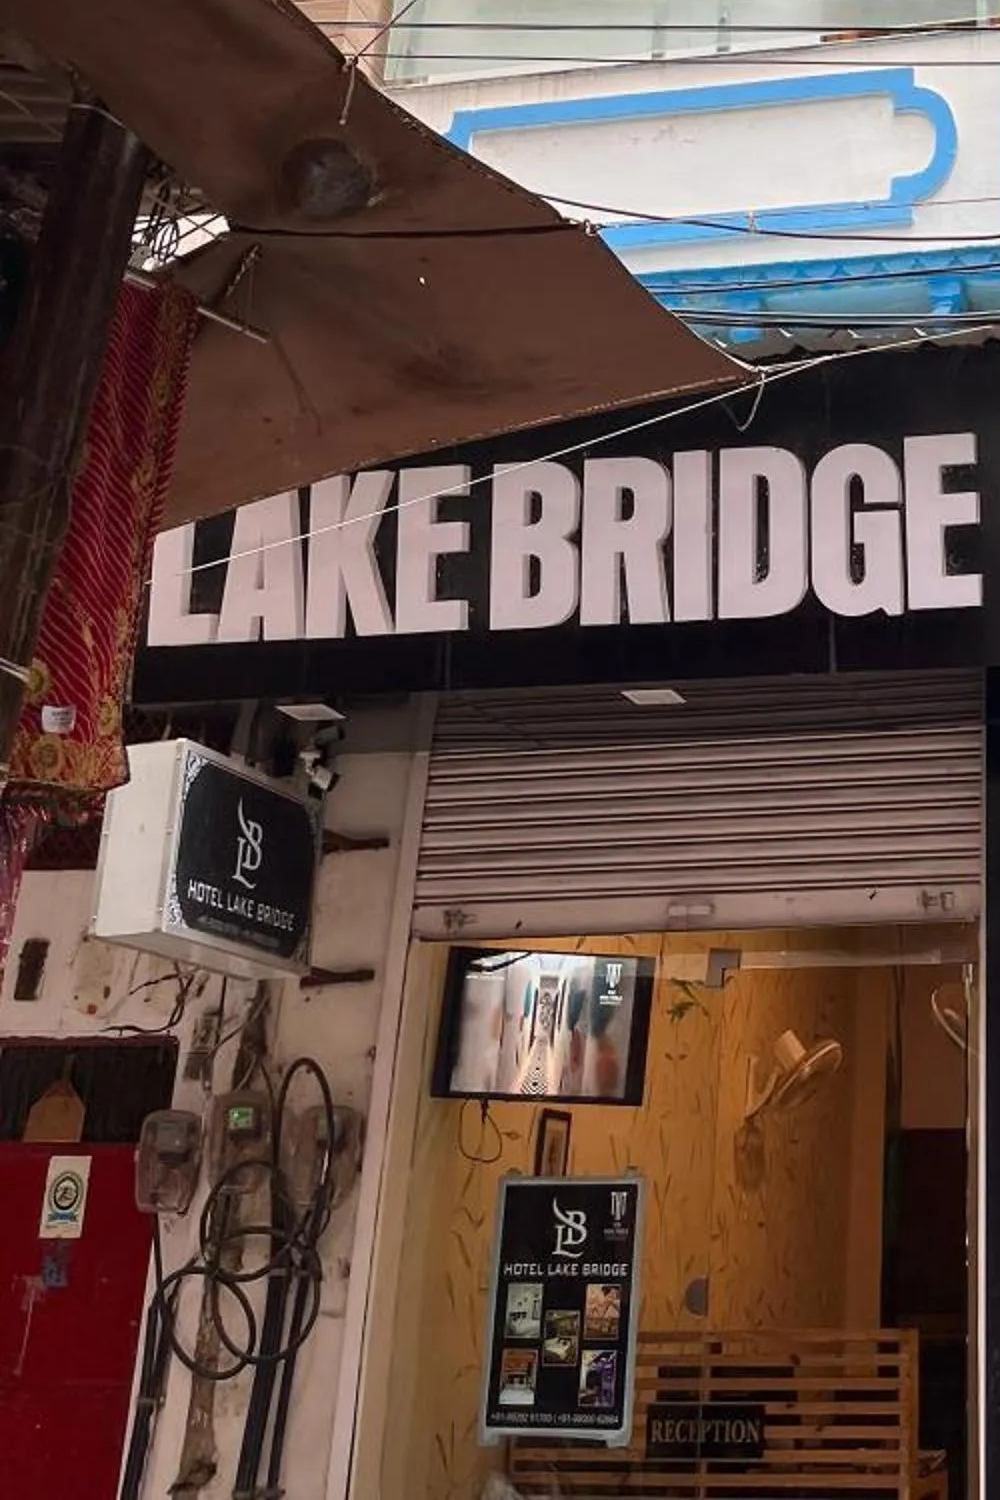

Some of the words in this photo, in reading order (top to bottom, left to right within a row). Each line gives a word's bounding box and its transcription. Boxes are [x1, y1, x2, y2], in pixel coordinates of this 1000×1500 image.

[147, 464, 471, 647] LAKE
[488, 433, 983, 631] BRIDGE
[187, 878, 224, 909] HOTEL
[227, 892, 254, 919] LAKE
[256, 903, 295, 932] BRIDGE
[503, 1263, 544, 1276] HOTEL
[547, 1263, 579, 1276] LAKE
[582, 1263, 629, 1276] BRIDGE
[651, 1419, 761, 1443] RECEPTION
